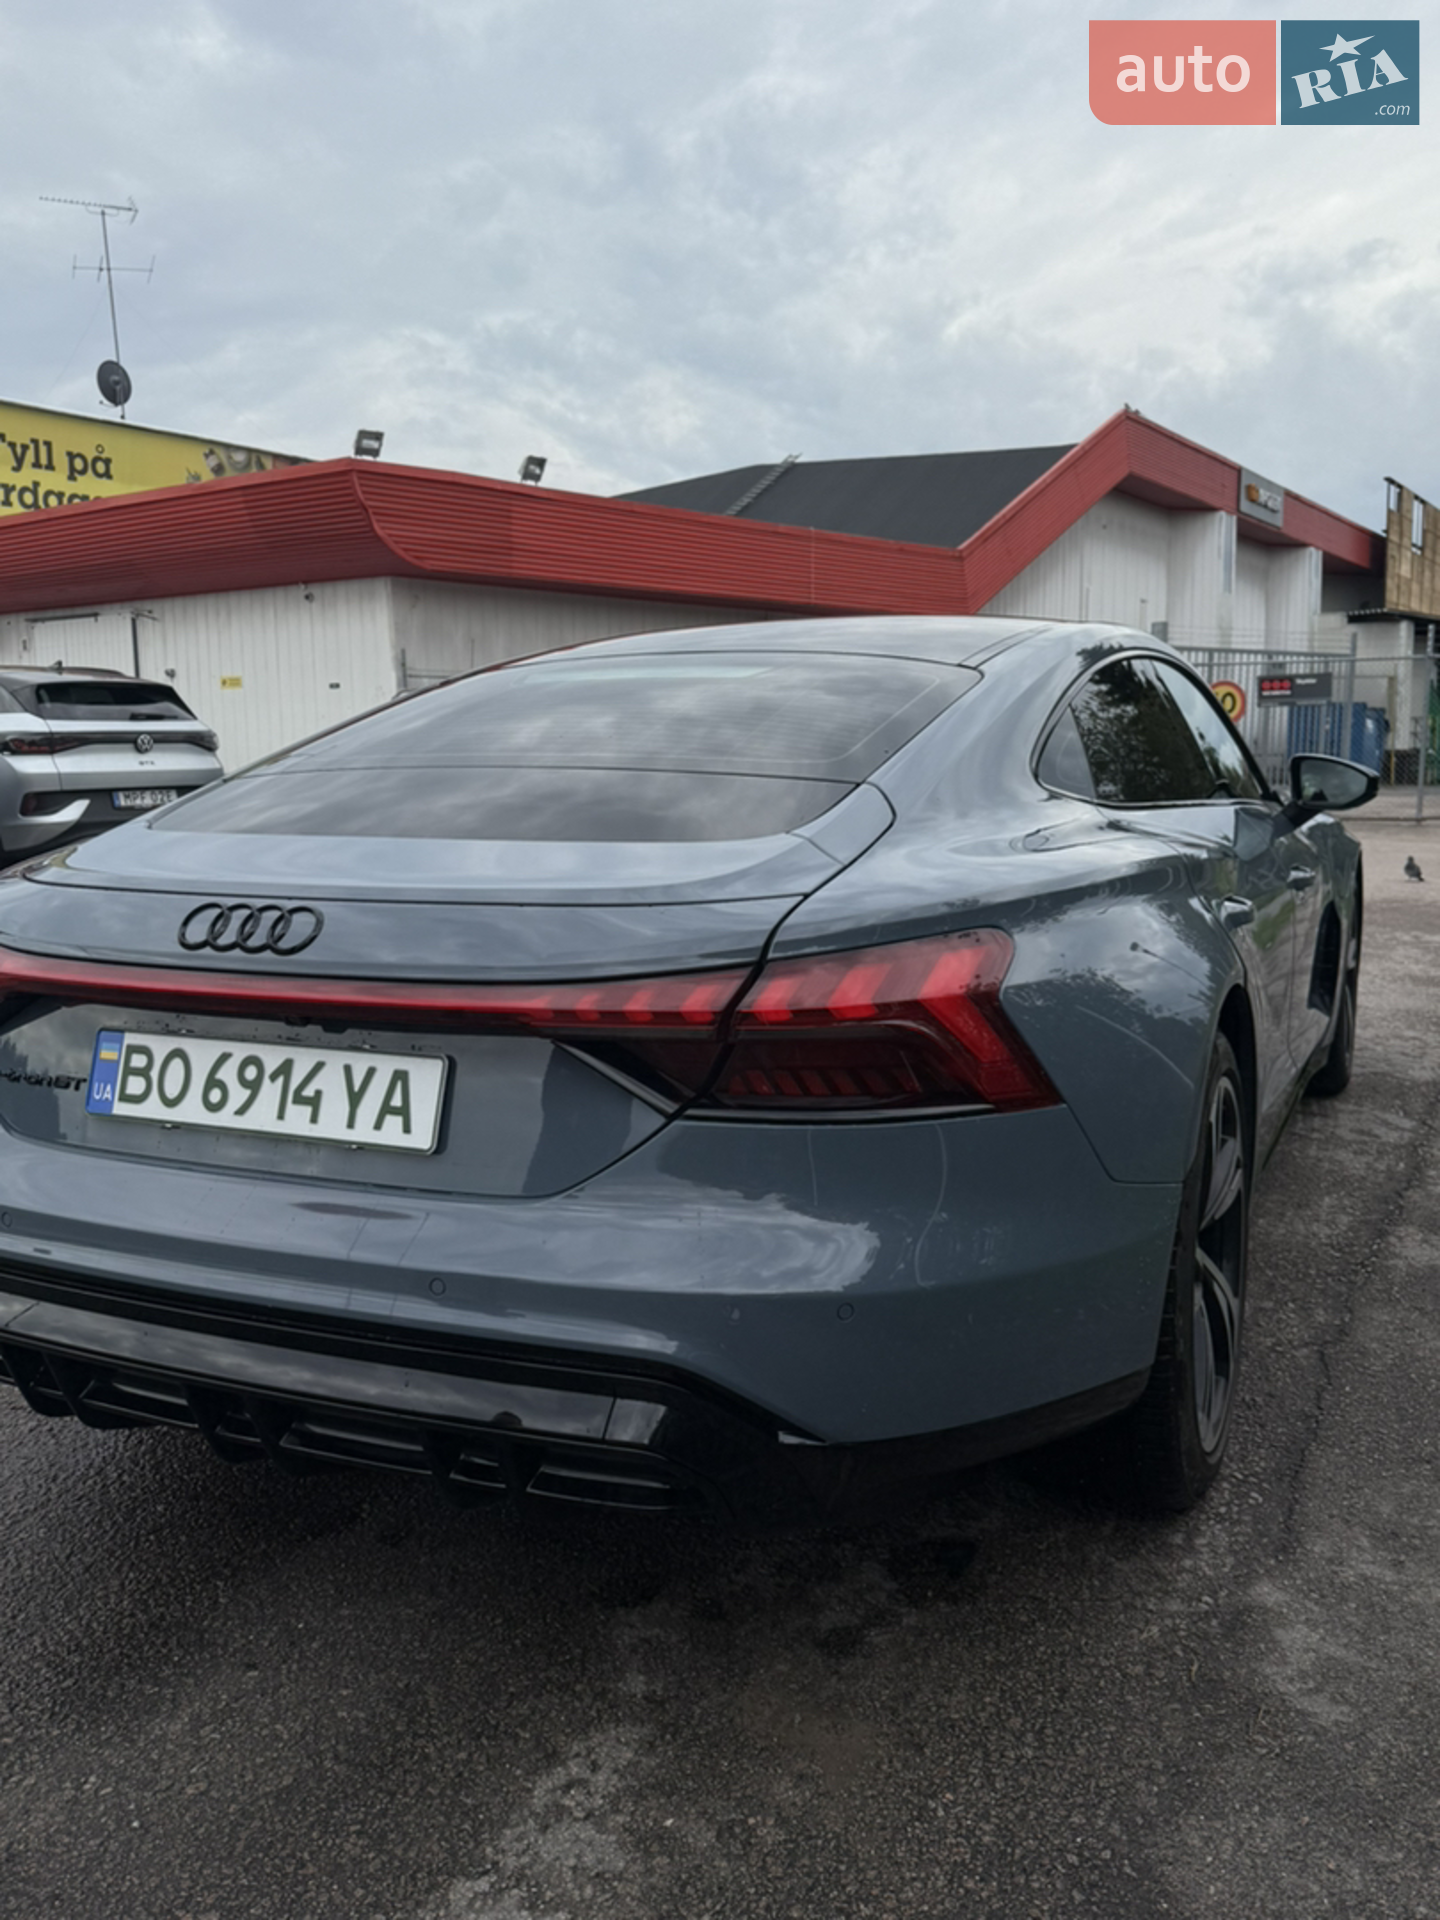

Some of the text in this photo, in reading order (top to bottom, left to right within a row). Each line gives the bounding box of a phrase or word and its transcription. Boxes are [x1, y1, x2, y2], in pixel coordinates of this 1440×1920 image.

[65, 443, 114, 482] på
[93, 1082, 113, 1101] UA
[118, 1043, 412, 1135] BO 6914 YA
